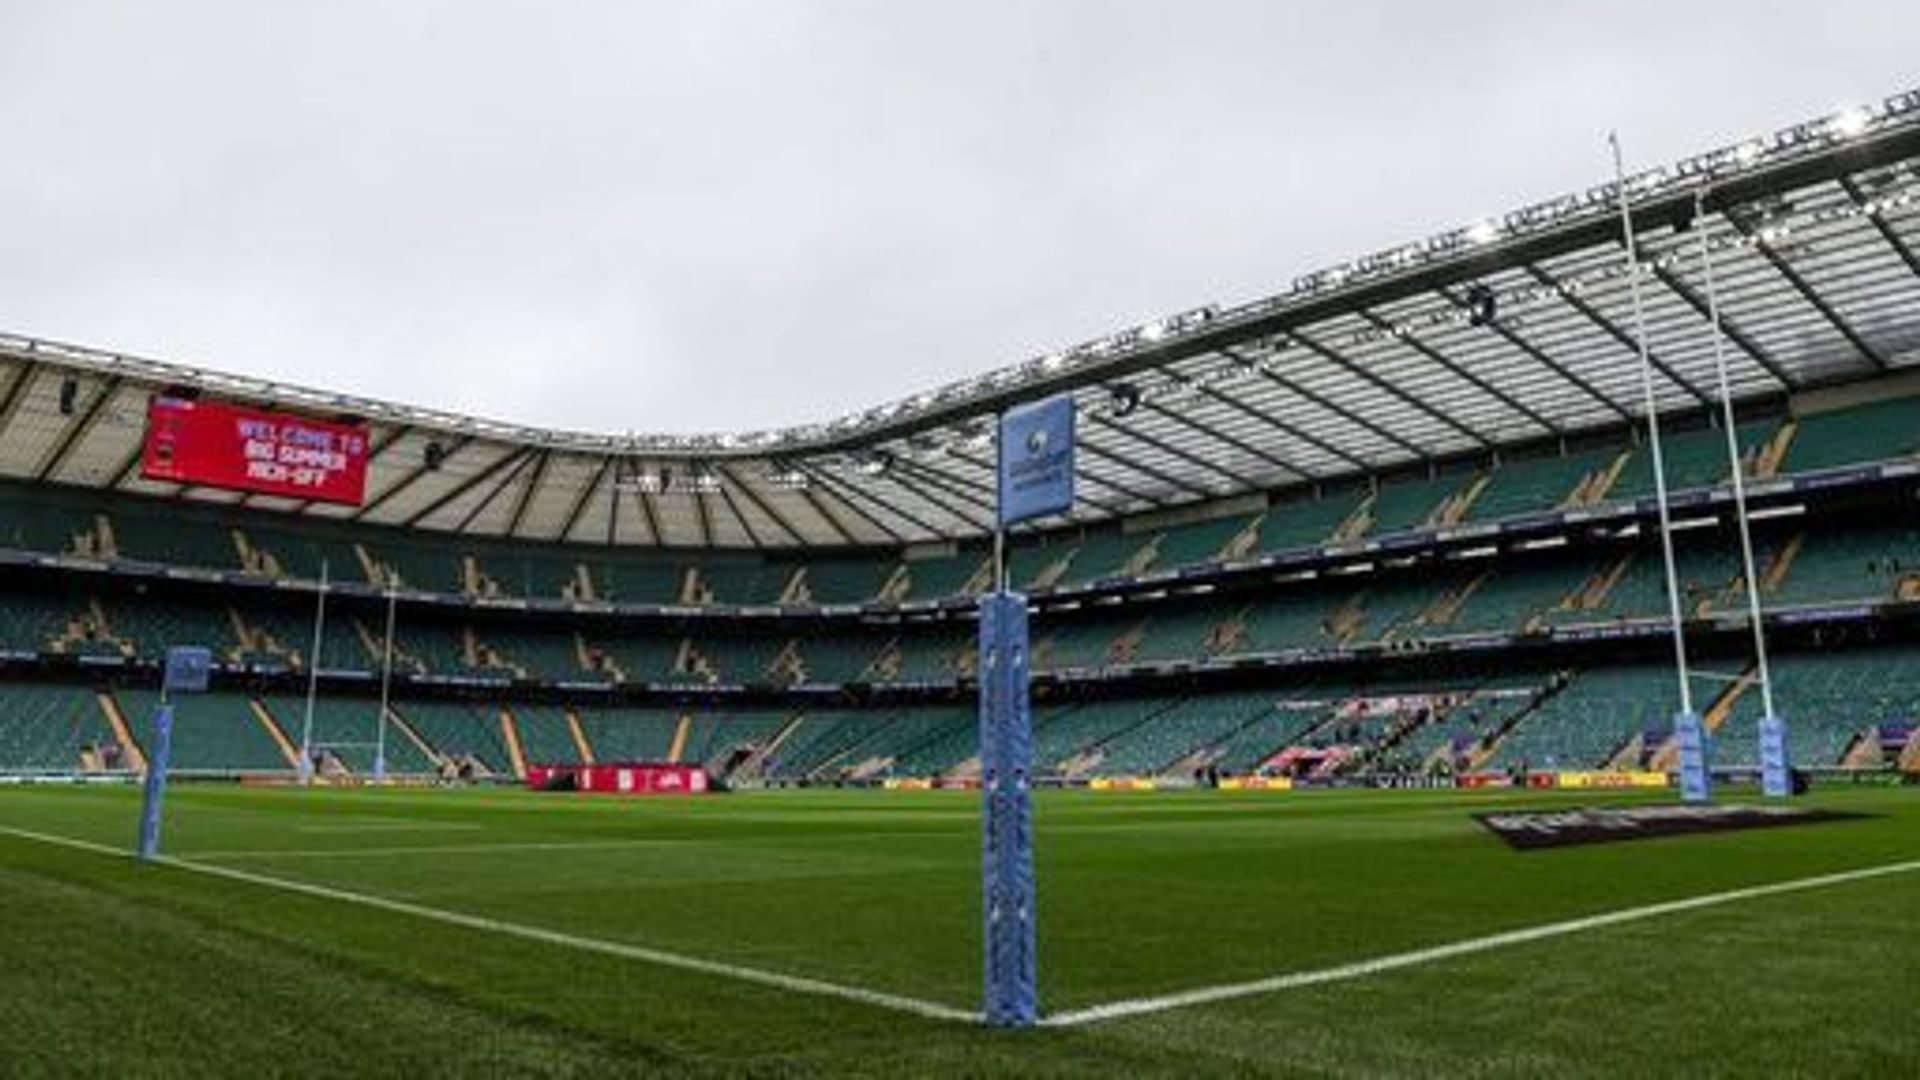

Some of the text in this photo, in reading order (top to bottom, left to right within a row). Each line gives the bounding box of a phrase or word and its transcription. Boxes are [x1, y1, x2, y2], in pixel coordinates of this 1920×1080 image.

[237, 420, 333, 446] WELCOME
[245, 440, 346, 470] BIG SUMMER
[248, 461, 326, 486] KICK-OFF
